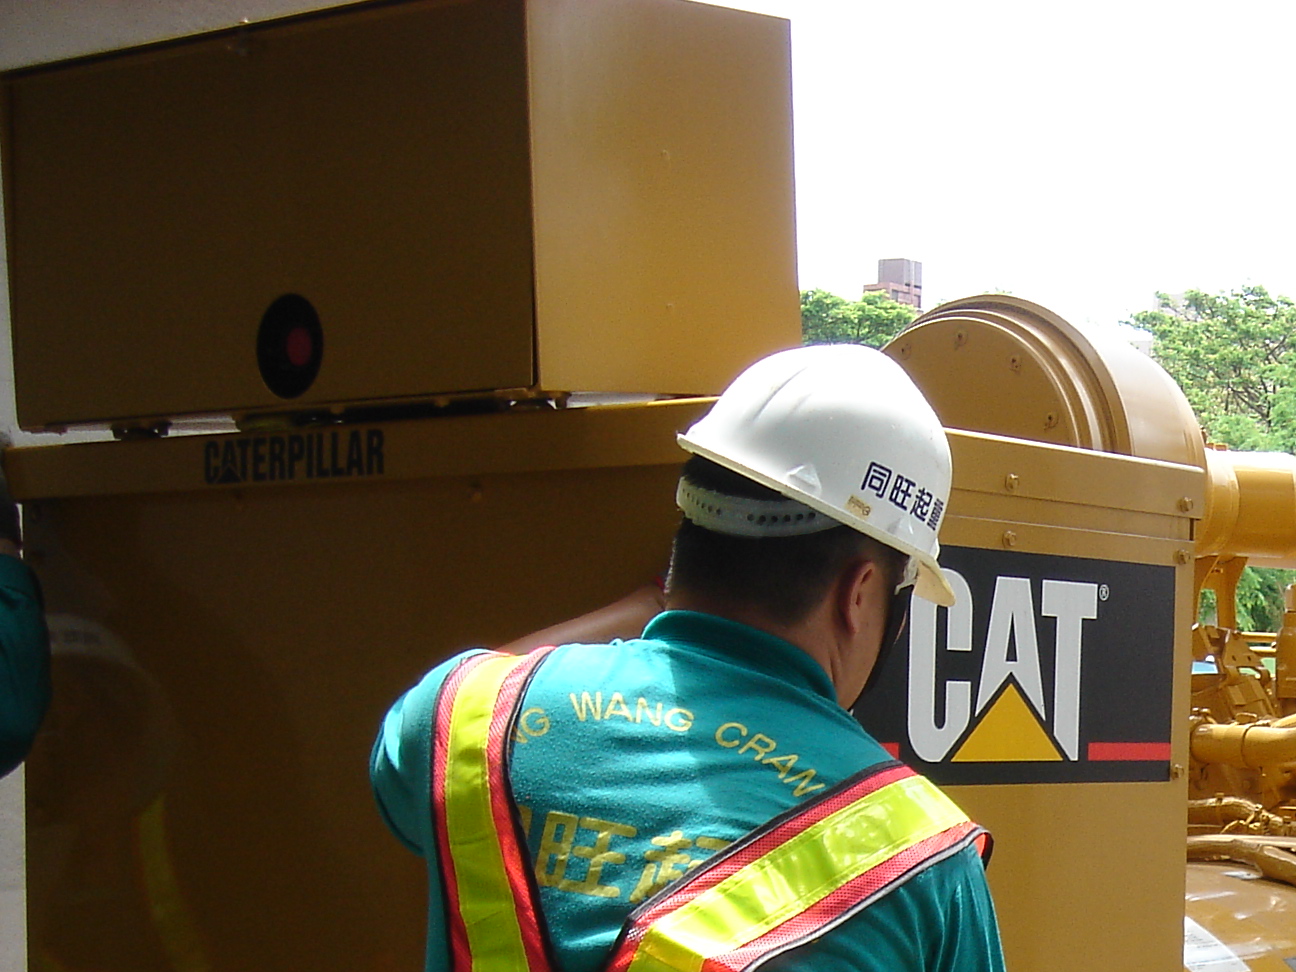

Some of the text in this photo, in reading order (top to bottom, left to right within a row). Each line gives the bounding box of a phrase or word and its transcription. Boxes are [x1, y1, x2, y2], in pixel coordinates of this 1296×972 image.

[204, 429, 385, 485] CATERPILLAR
[908, 568, 1098, 763] CAT
[569, 691, 695, 732] WANG
